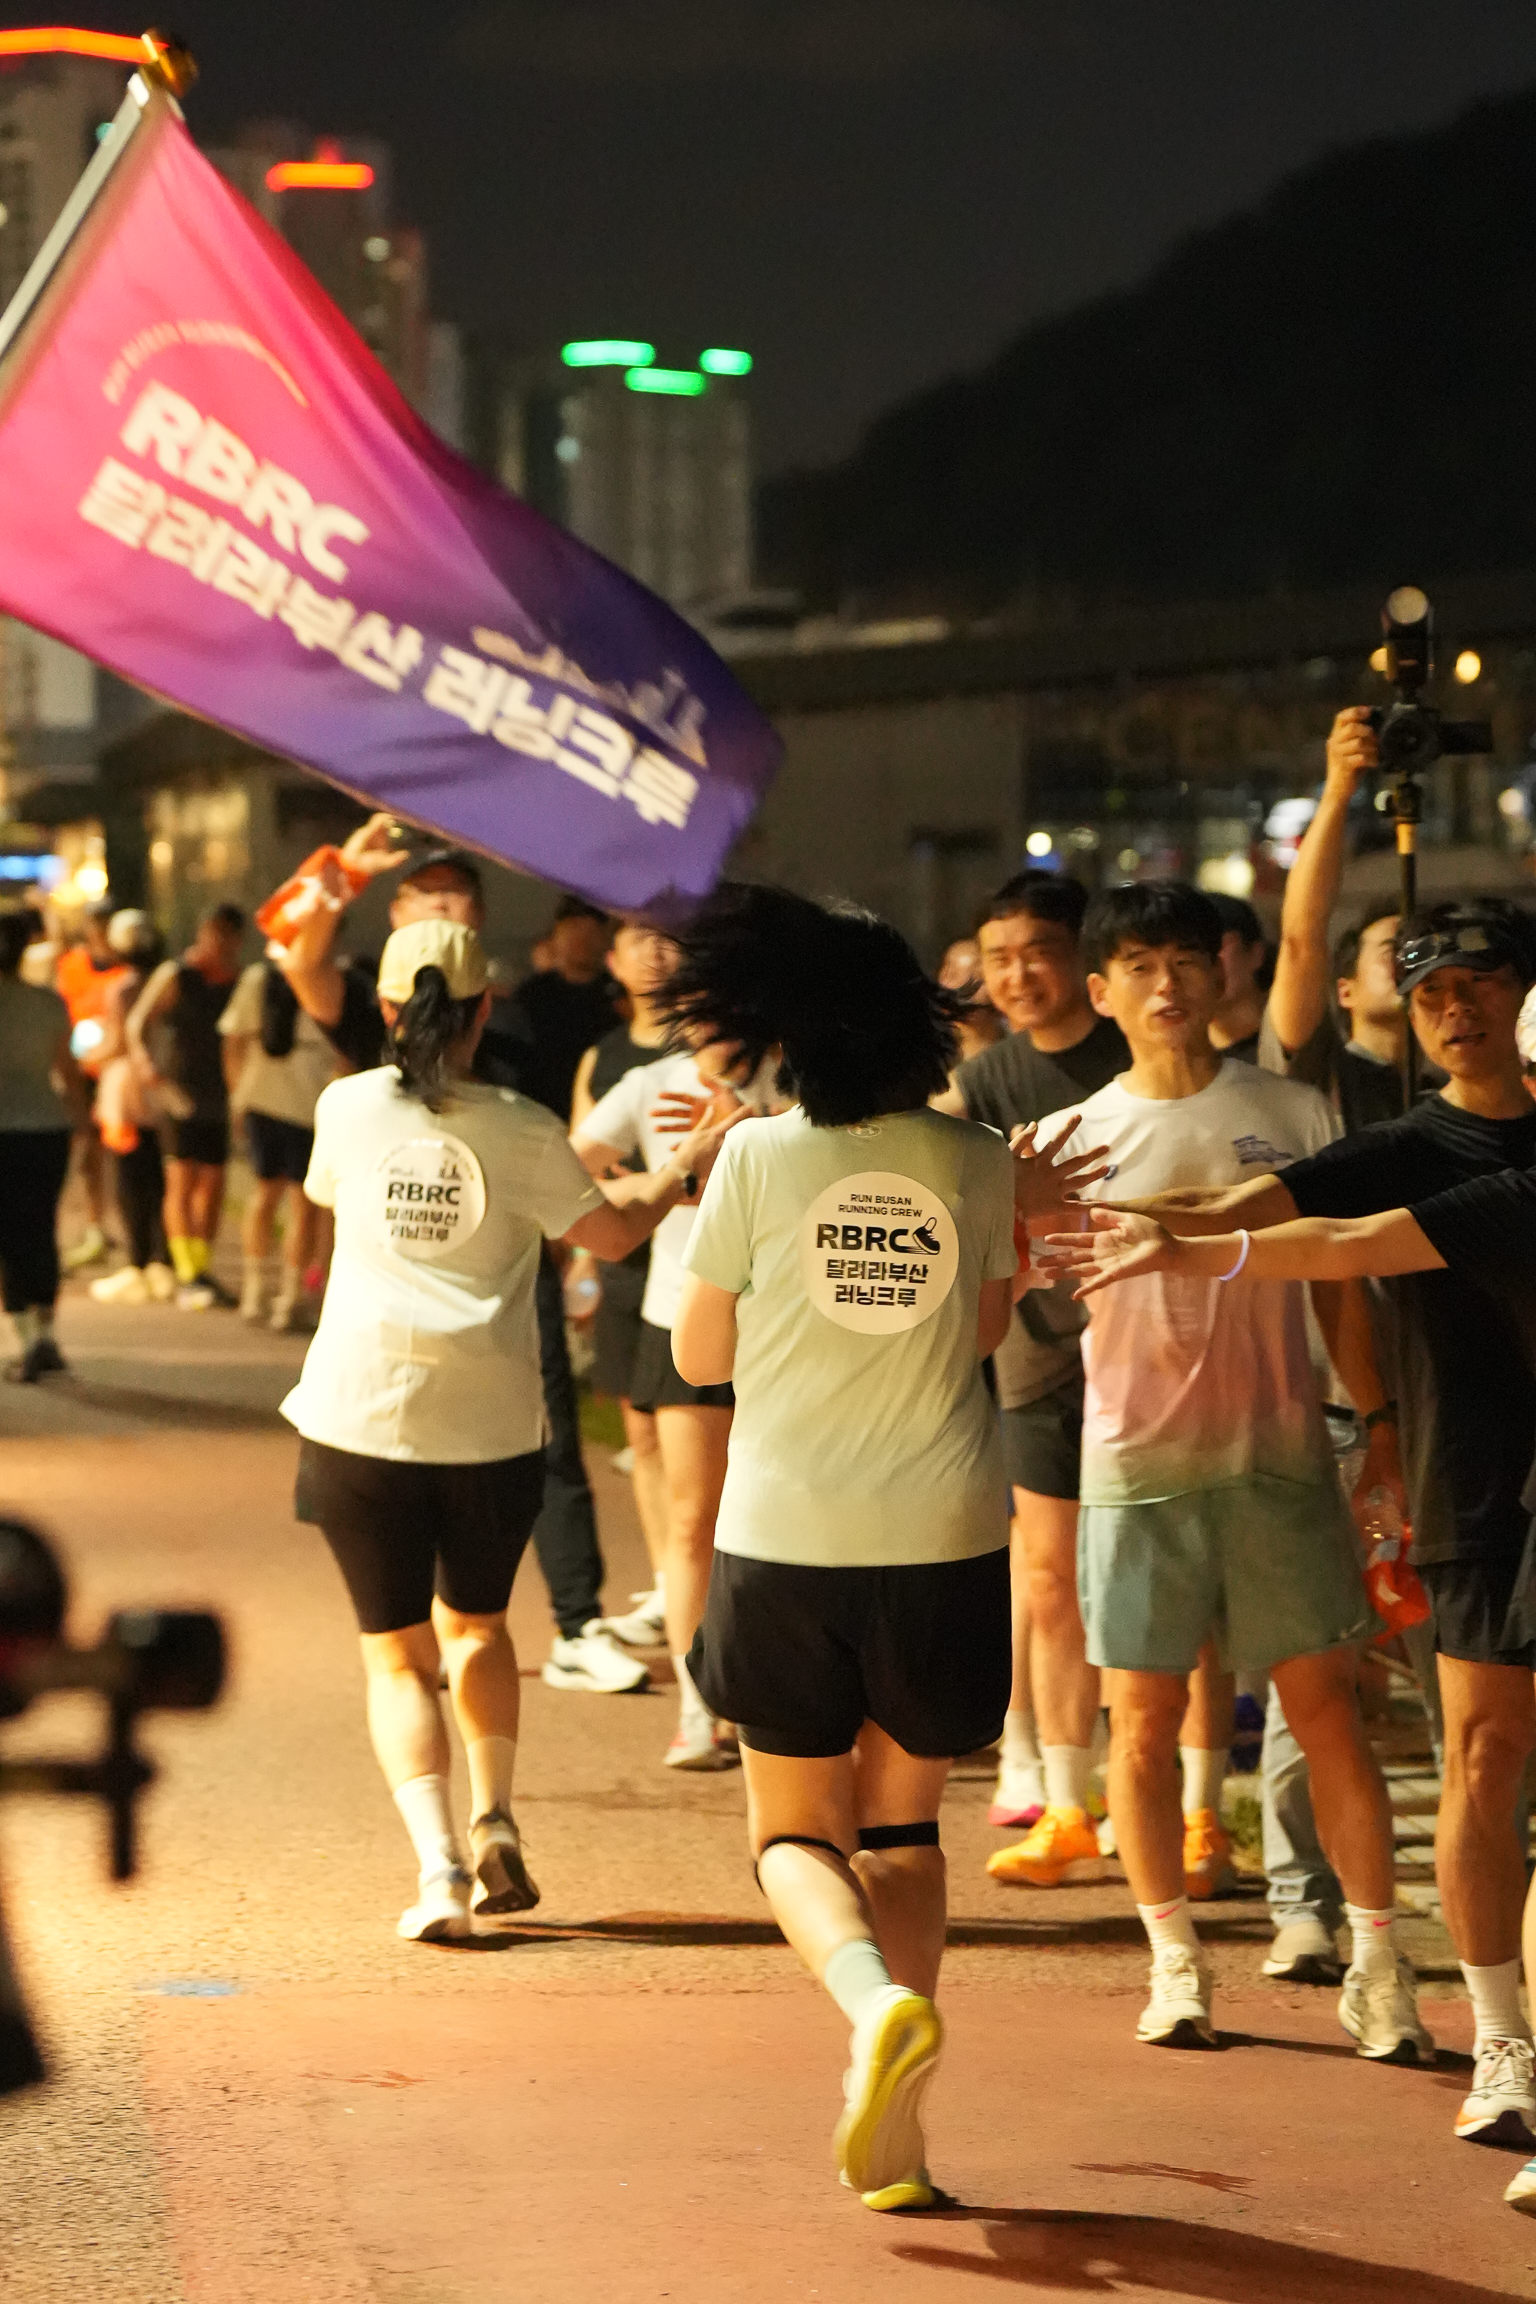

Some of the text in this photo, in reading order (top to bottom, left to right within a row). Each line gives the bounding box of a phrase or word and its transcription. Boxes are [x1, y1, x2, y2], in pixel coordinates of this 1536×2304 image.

[122, 381, 371, 582] RBRC
[424, 646, 699, 830] 러닝크루
[388, 1182, 461, 1205] RBRC
[850, 1194, 912, 1205] RUN BUSAN
[838, 1204, 922, 1217] RUNNING CREW
[816, 1223, 910, 1253] RBRC
[826, 1259, 929, 1284] 달려라부산
[835, 1284, 917, 1307] 러닝크루
